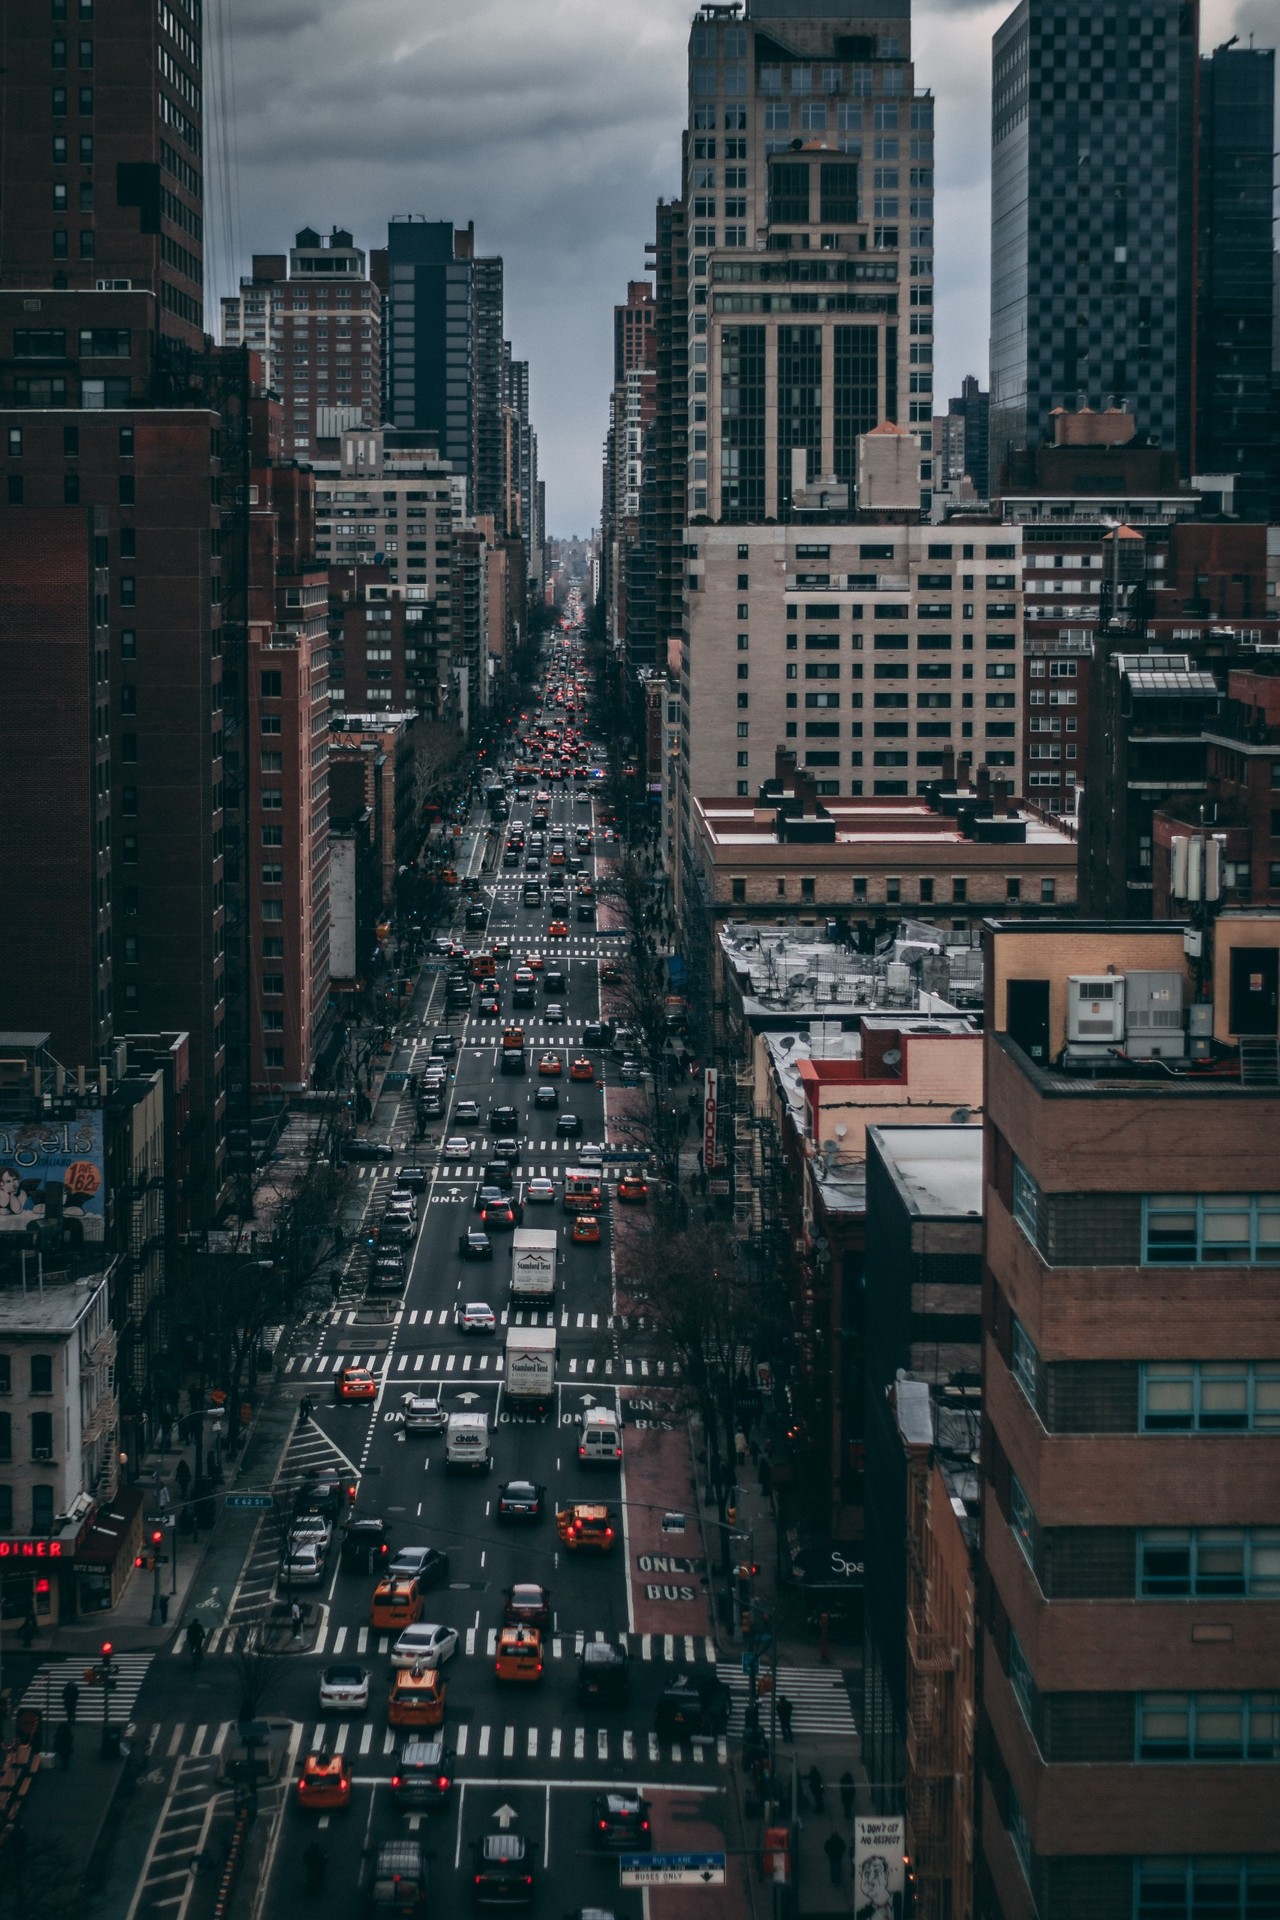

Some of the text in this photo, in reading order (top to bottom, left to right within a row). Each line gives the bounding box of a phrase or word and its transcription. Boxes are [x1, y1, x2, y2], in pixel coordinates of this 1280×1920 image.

[705, 1070, 716, 1166] LIQUORS
[78, 1164, 94, 1174] AVE
[431, 1195, 468, 1203] ONLY
[629, 1400, 677, 1412] ONLY
[500, 1412, 550, 1424] ONLY
[635, 1419, 675, 1431] BUS
[0, 1541, 62, 1557] DINER
[639, 1555, 699, 1574] ONLY
[646, 1584, 695, 1601] BUS
[652, 1856, 692, 1864] BUS LANE
[635, 1872, 683, 1881] BUSES ONLY
